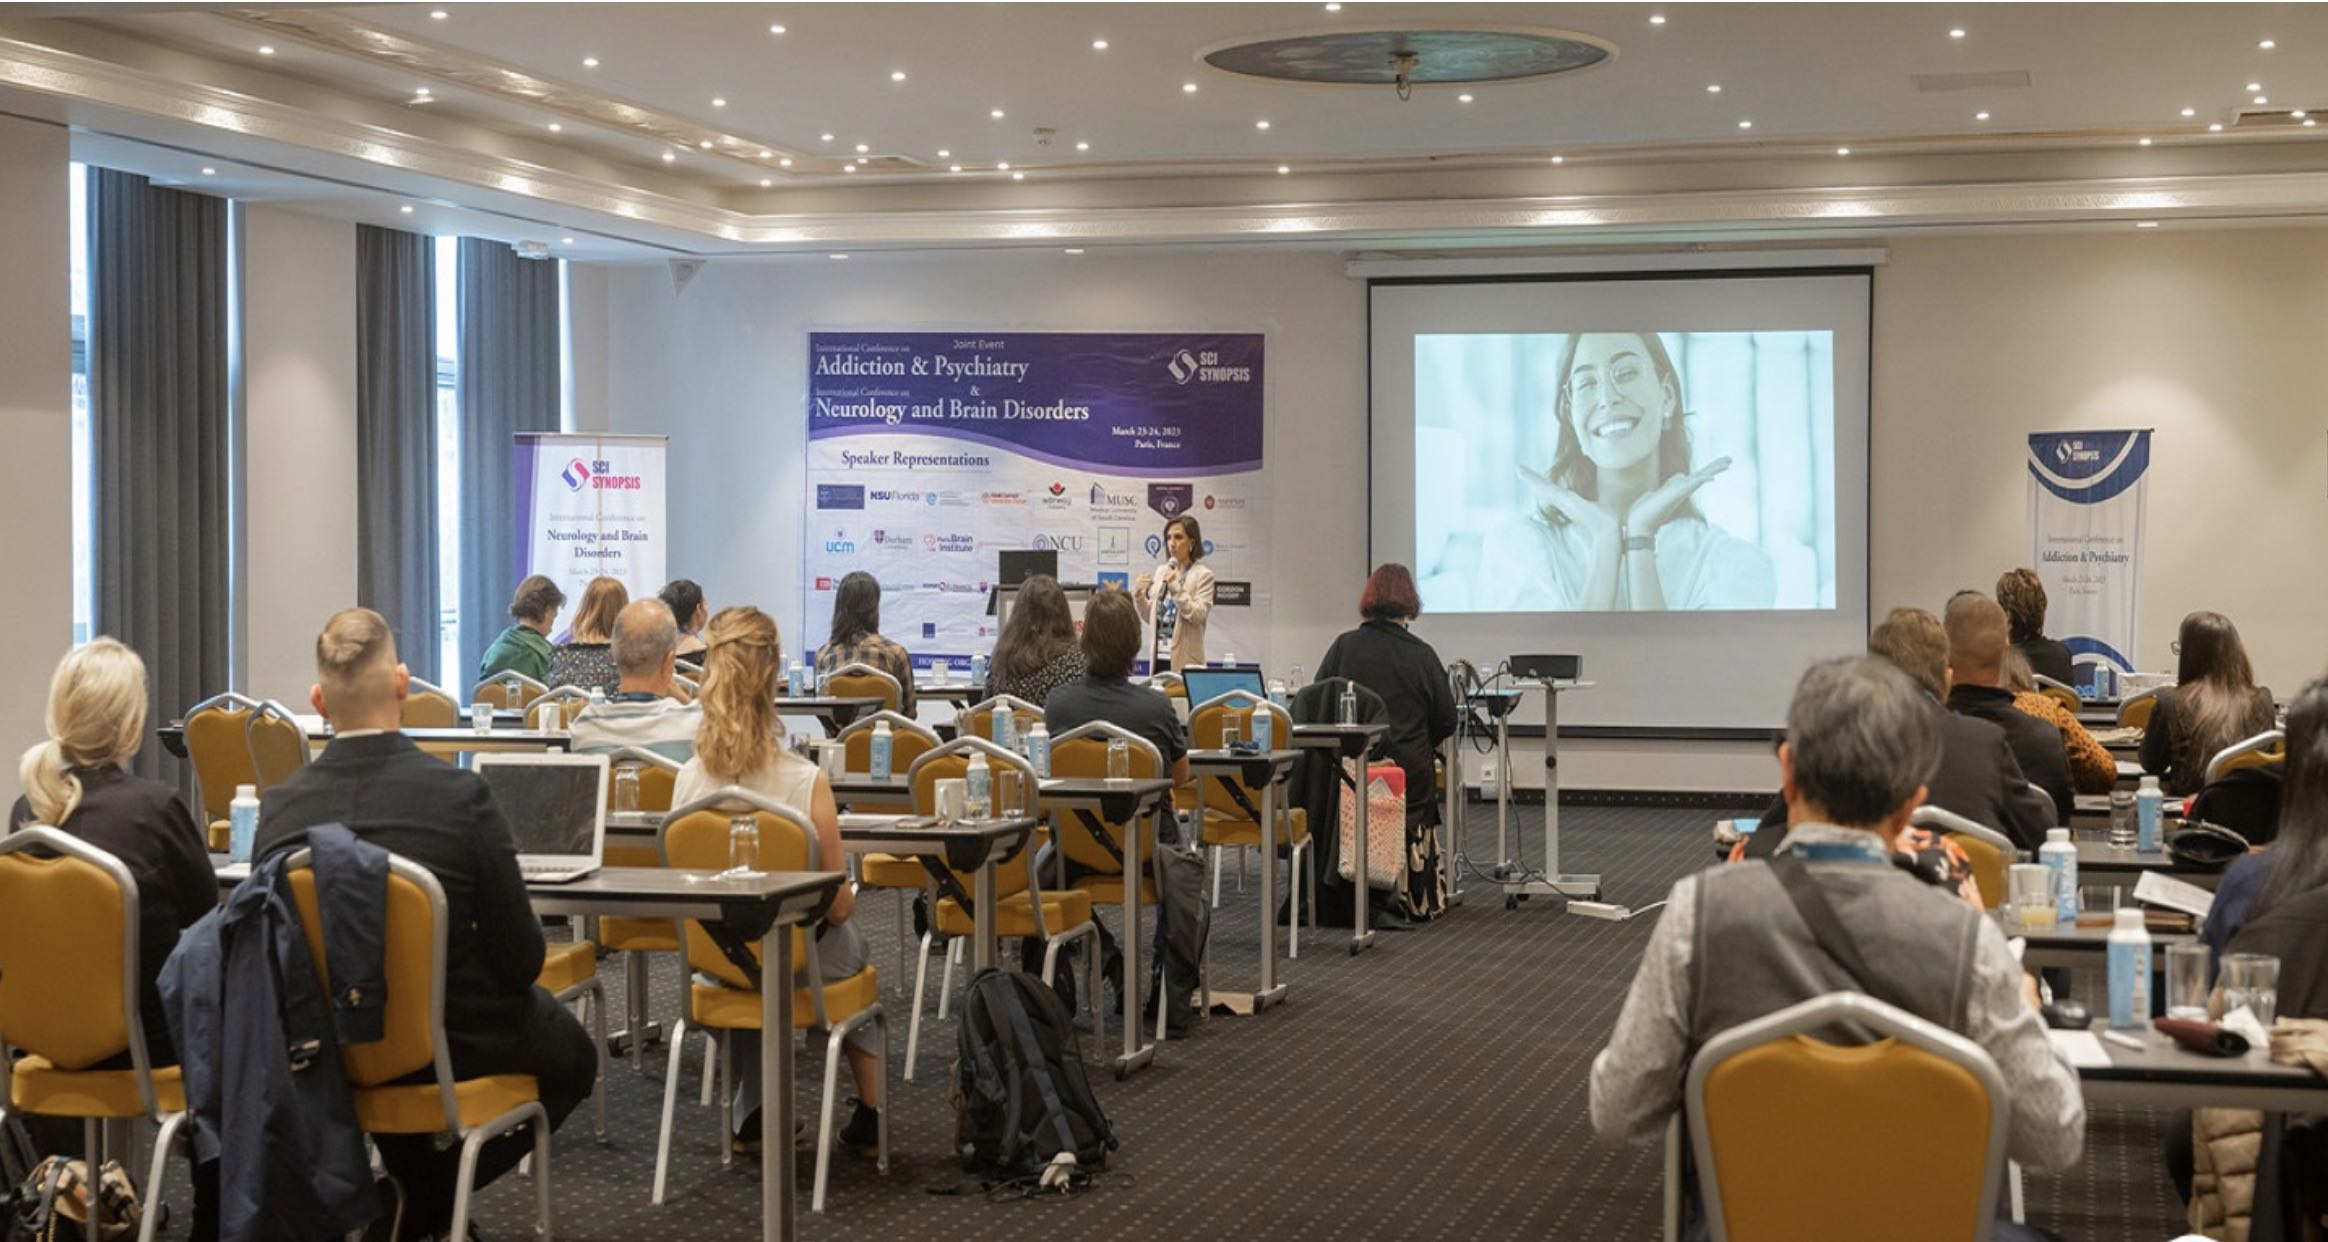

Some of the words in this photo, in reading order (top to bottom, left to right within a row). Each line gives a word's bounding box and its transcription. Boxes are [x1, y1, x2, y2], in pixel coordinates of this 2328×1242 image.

[953, 340, 976, 349] Joint
[979, 340, 1004, 349] Event
[1200, 351, 1218, 365] SCI
[816, 355, 905, 376] Addiction
[911, 356, 928, 376] &
[935, 355, 1029, 382] Psychiatry
[1199, 367, 1250, 382] SYNOPSIS
[970, 385, 980, 397] &
[816, 398, 907, 425] Neurology
[911, 398, 944, 418] and
[950, 399, 998, 419] Brain
[1003, 399, 1089, 420] Disorders
[1112, 426, 1135, 436] March
[1162, 426, 1181, 437] 2023
[1157, 439, 1180, 449] France
[592, 460, 610, 474] SCI
[842, 450, 889, 470] Speaker
[893, 450, 990, 469] Representations
[592, 476, 641, 490] SYNOPSIS
[1107, 495, 1137, 506] MUSC
[547, 529, 599, 544] Neurology
[600, 529, 619, 541] and
[621, 529, 649, 541] Brain
[951, 533, 973, 543] Brain
[1050, 535, 1083, 550] NCU
[574, 547, 622, 558] Disorders
[940, 544, 974, 552] Institute
[2042, 551, 2079, 562] Addiction
[2080, 551, 2087, 562] &
[2088, 551, 2129, 567] Psychiatry
